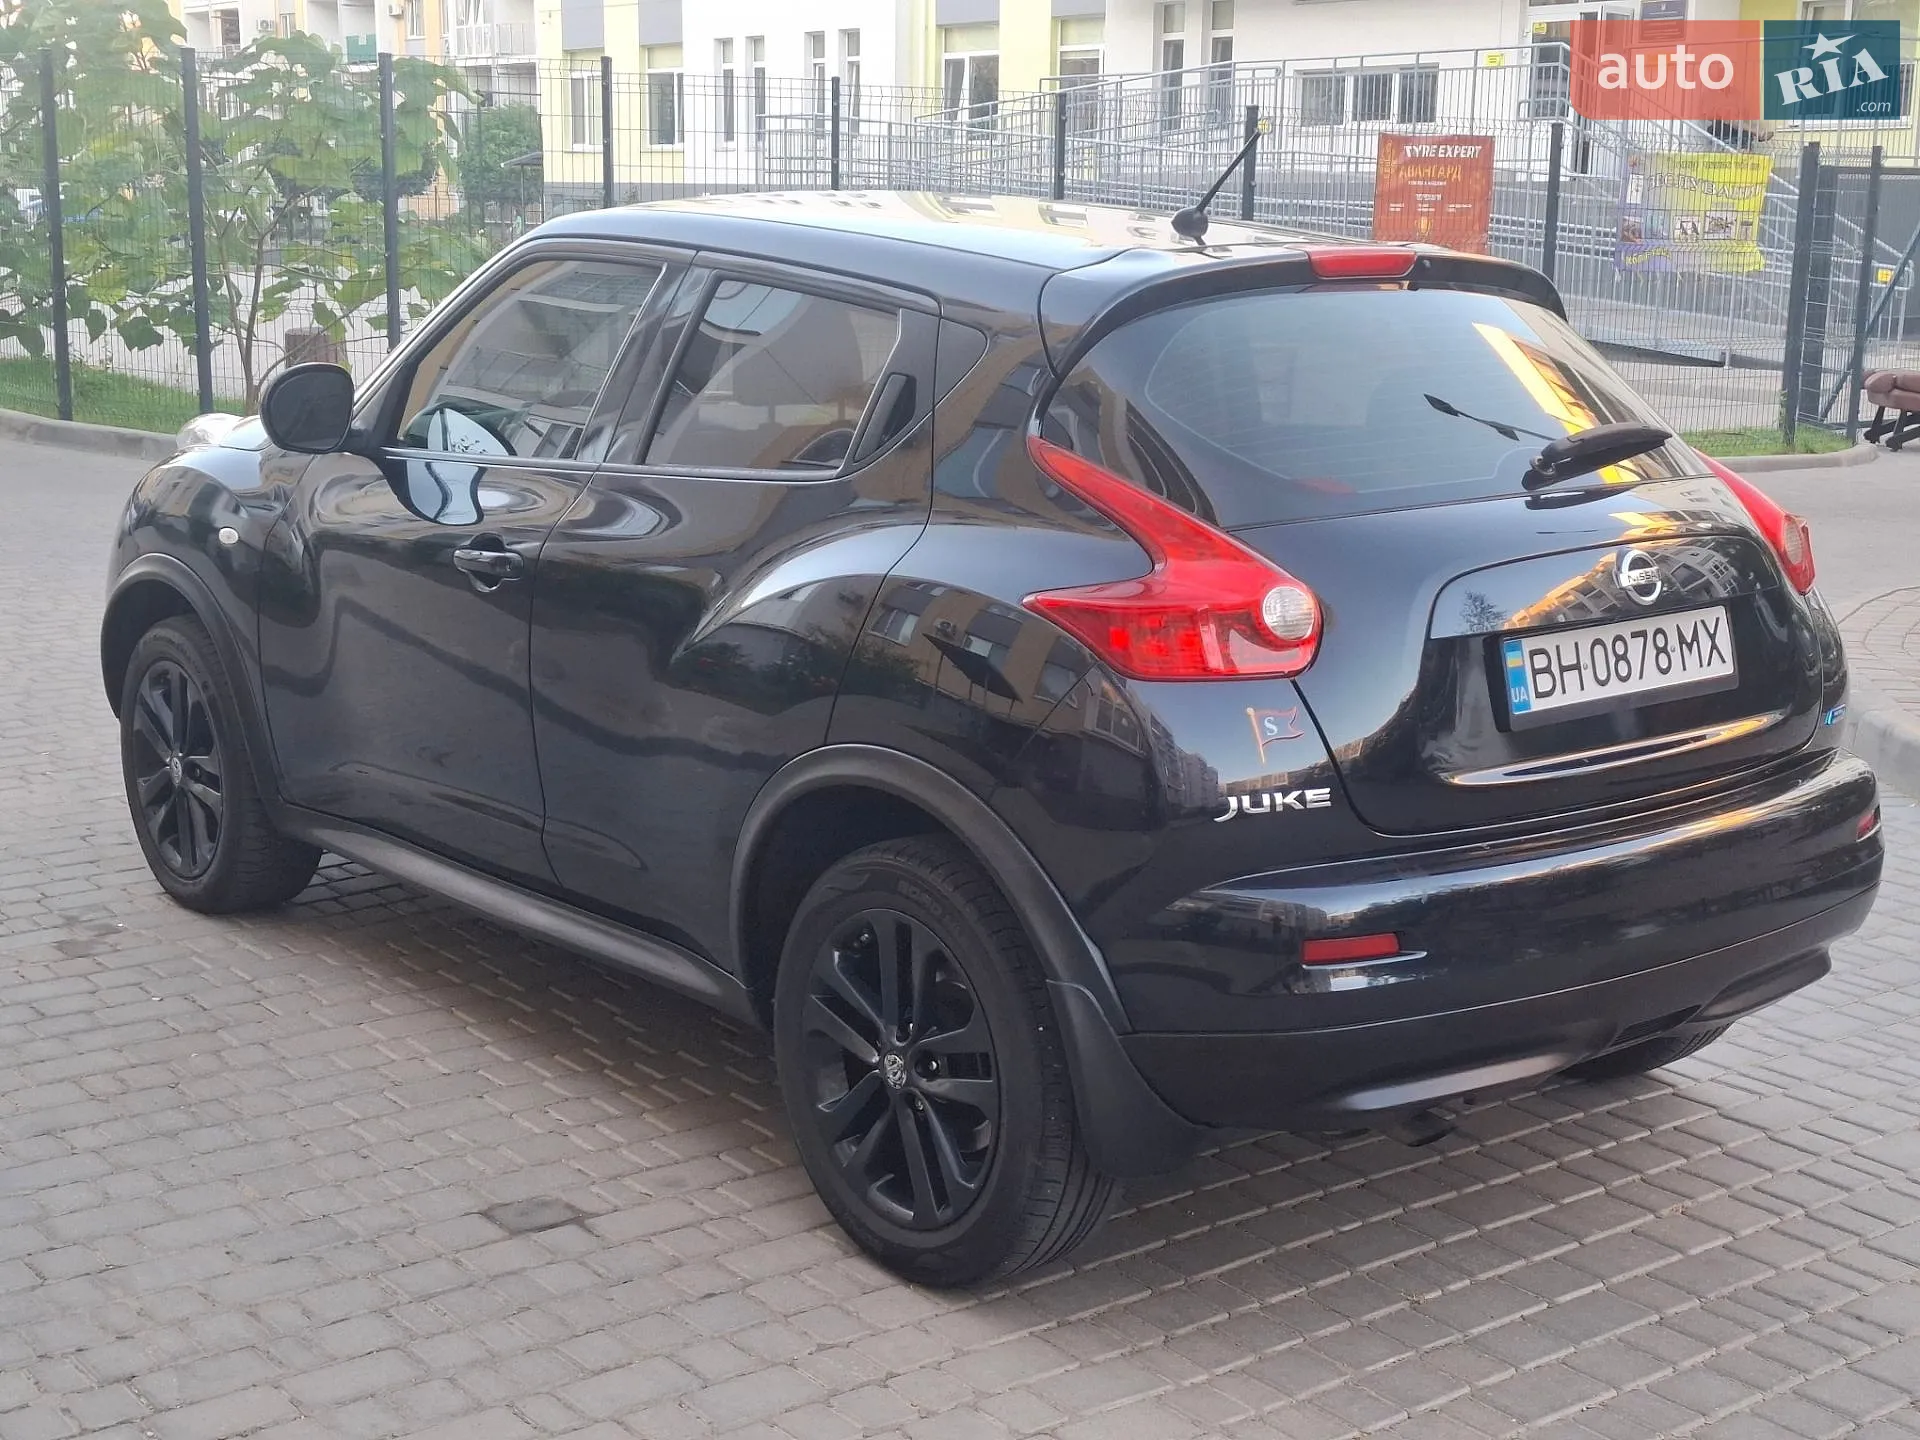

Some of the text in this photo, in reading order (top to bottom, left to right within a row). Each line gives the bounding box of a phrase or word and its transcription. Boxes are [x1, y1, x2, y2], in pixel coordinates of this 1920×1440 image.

[1403, 144, 1482, 159] TYRE EXPERT
[1511, 617, 1726, 703] UA BH 0878 MX
[1213, 787, 1332, 823] JUKE
